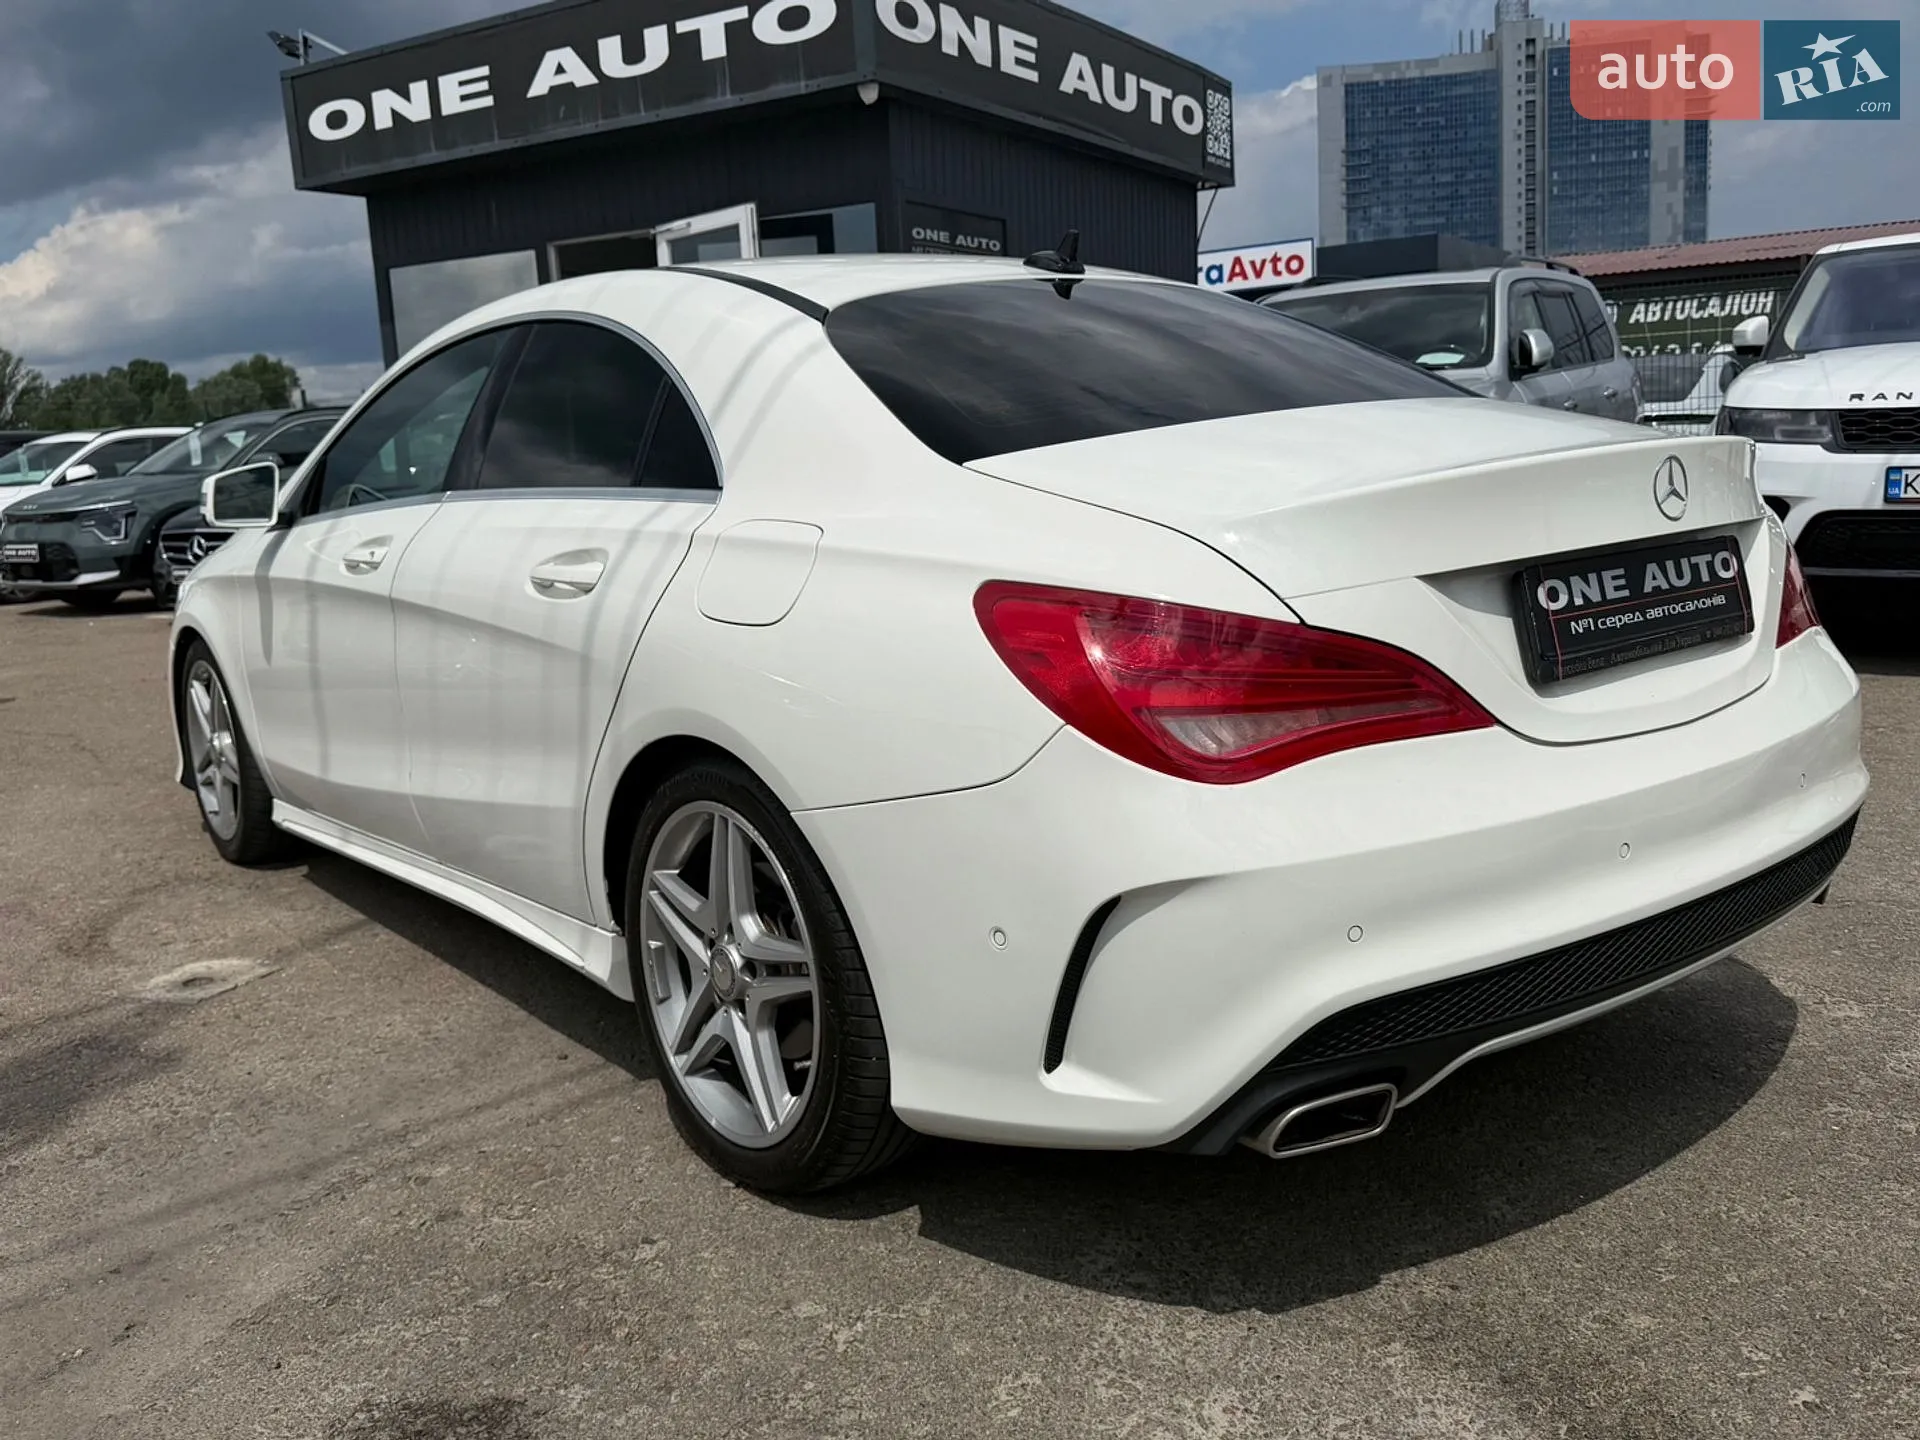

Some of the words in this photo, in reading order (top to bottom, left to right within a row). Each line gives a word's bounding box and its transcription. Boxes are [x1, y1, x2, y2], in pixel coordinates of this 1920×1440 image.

[308, 65, 494, 141] ONE
[526, 0, 837, 98] AUTO
[875, 0, 1039, 84] ONE
[1059, 51, 1204, 136] AUTO
[912, 227, 950, 244] ONE
[955, 234, 1000, 251] AUTO
[1628, 291, 1775, 324] АВТОСАЛОН
[1537, 567, 1630, 611] ONE
[1643, 550, 1739, 593] AUTO
[1570, 619, 1595, 635] №1
[1598, 610, 1644, 633] серед
[1646, 592, 1726, 619] автосалонів
